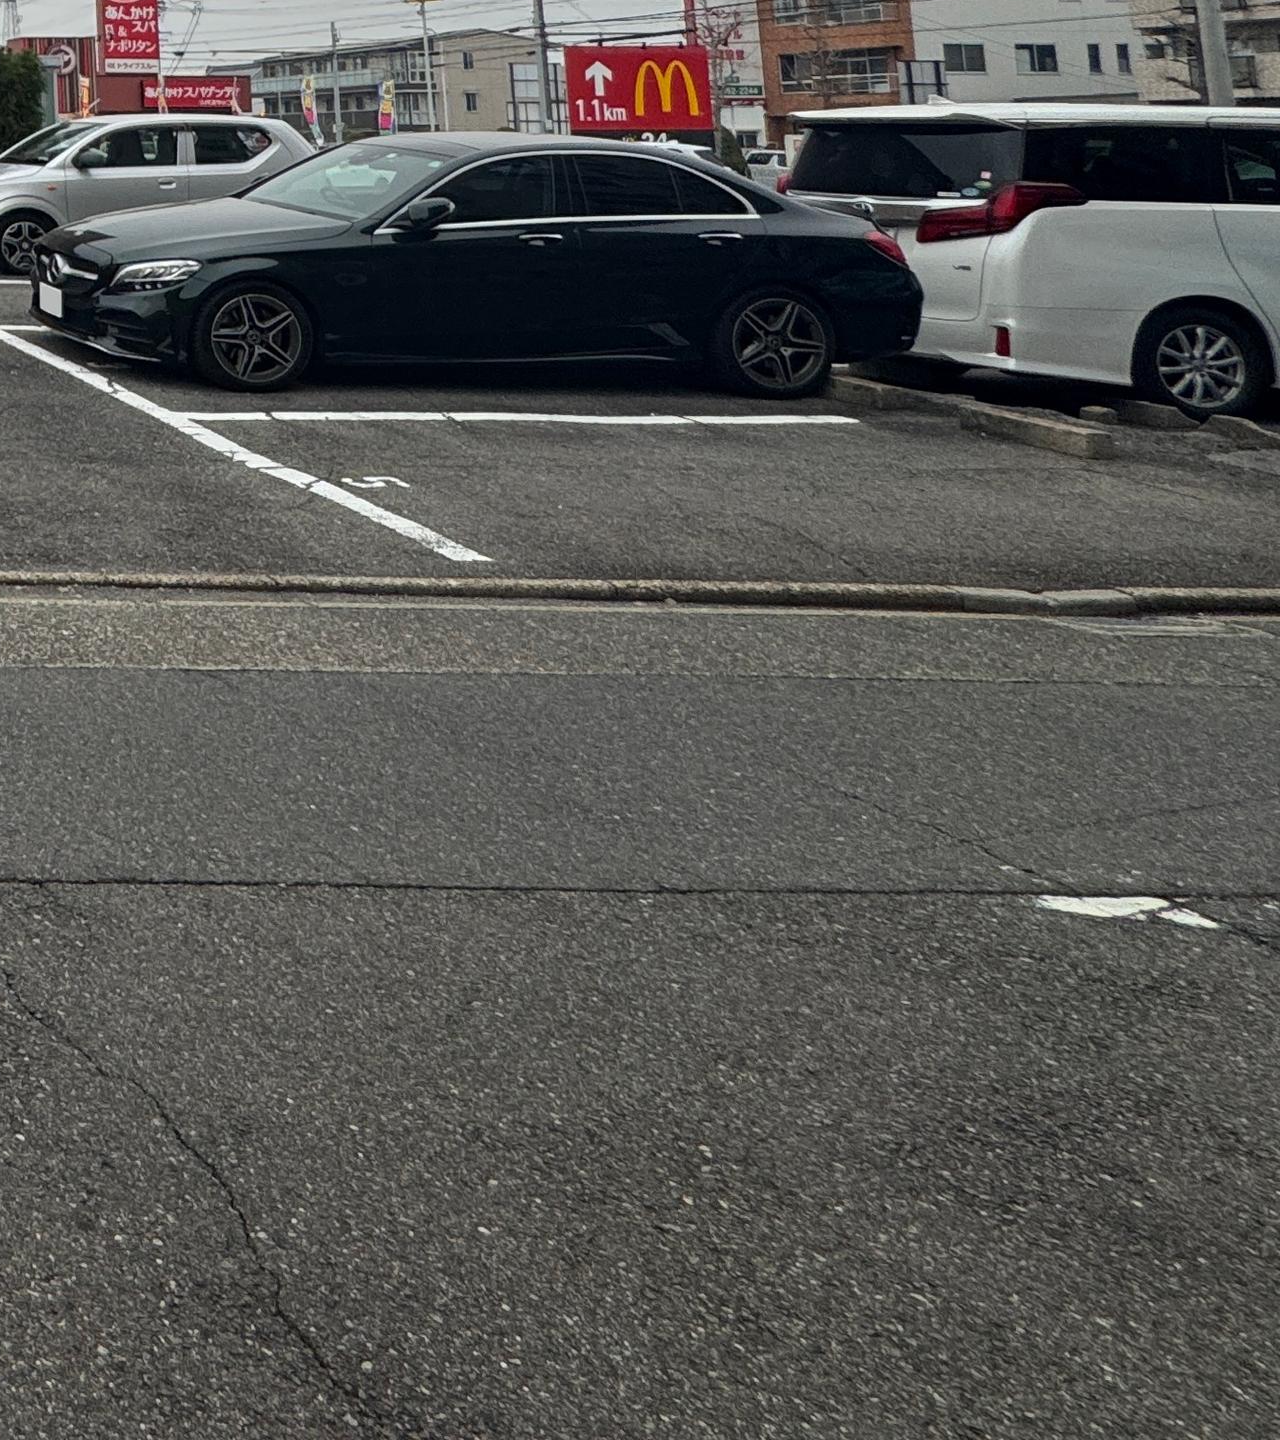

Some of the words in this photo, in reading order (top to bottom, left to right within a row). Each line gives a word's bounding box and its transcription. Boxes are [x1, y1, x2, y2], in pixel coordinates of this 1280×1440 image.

[105, 5, 155, 20] あんかけ
[132, 20, 156, 33] スパ
[106, 39, 156, 53] ナポリタン
[340, 476, 411, 488] 5
